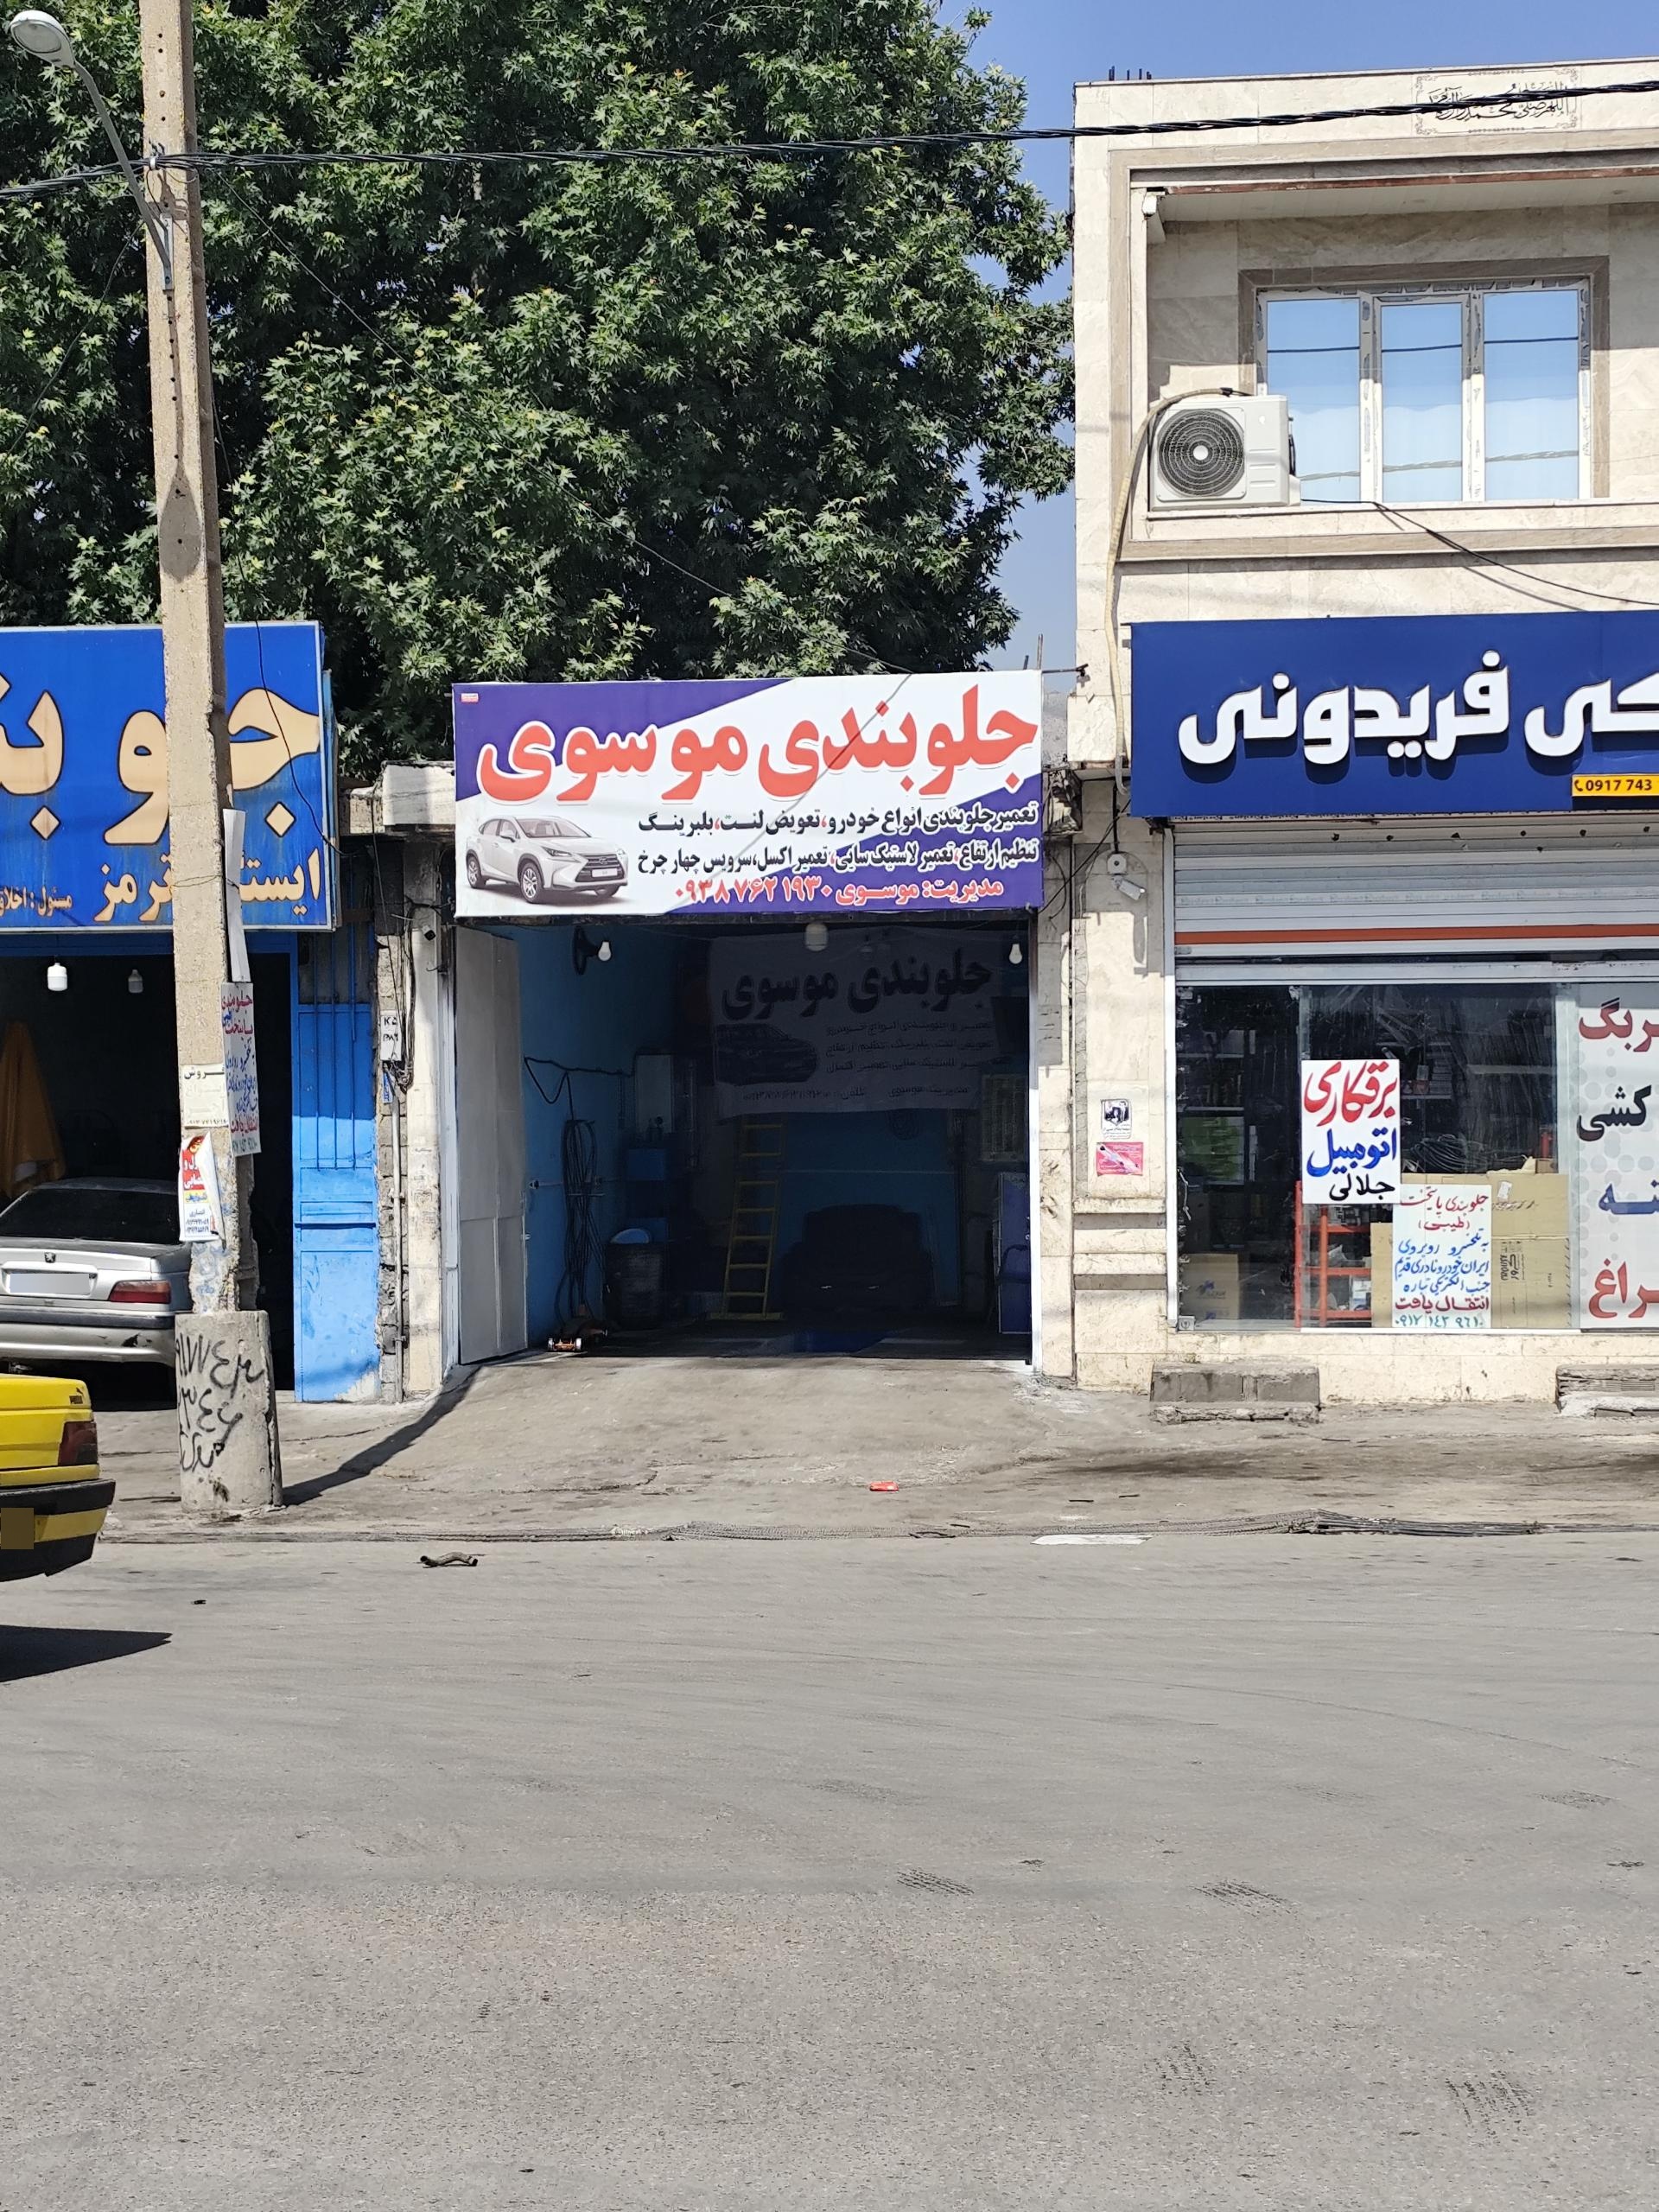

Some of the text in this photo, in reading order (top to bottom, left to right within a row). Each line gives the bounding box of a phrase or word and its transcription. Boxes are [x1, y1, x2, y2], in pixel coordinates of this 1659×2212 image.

[1179, 650, 1509, 765] فریدونی
[480, 684, 1039, 801] جلوبندی موسوی
[1586, 779, 1652, 791] 0917 743
[639, 810, 713, 837] بلبرینگ
[766, 810, 821, 836] تعویض
[881, 806, 922, 832] انواع
[923, 804, 995, 832] جلوبندی
[996, 803, 1038, 830] تعمیر
[638, 849, 668, 874] چرخ
[703, 853, 752, 873] سرویس
[794, 846, 828, 871] تعمیر
[920, 842, 953, 871] تعمیر
[1001, 838, 1039, 867] تنظیم
[836, 883, 918, 906] موسوی
[923, 880, 1003, 904] مدیریت:
[722, 946, 992, 1021] جلوبندی موسوی
[1304, 1061, 1397, 1127] برقکاری
[1576, 1084, 1651, 1141] کشی
[1306, 1127, 1397, 1177] اتومبیل
[1329, 1173, 1395, 1201] جلالی
[1445, 1194, 1489, 1217] جلوبندی
[1460, 1260, 1490, 1277] ایران
[1395, 1294, 1489, 1313] انتقال یافت
